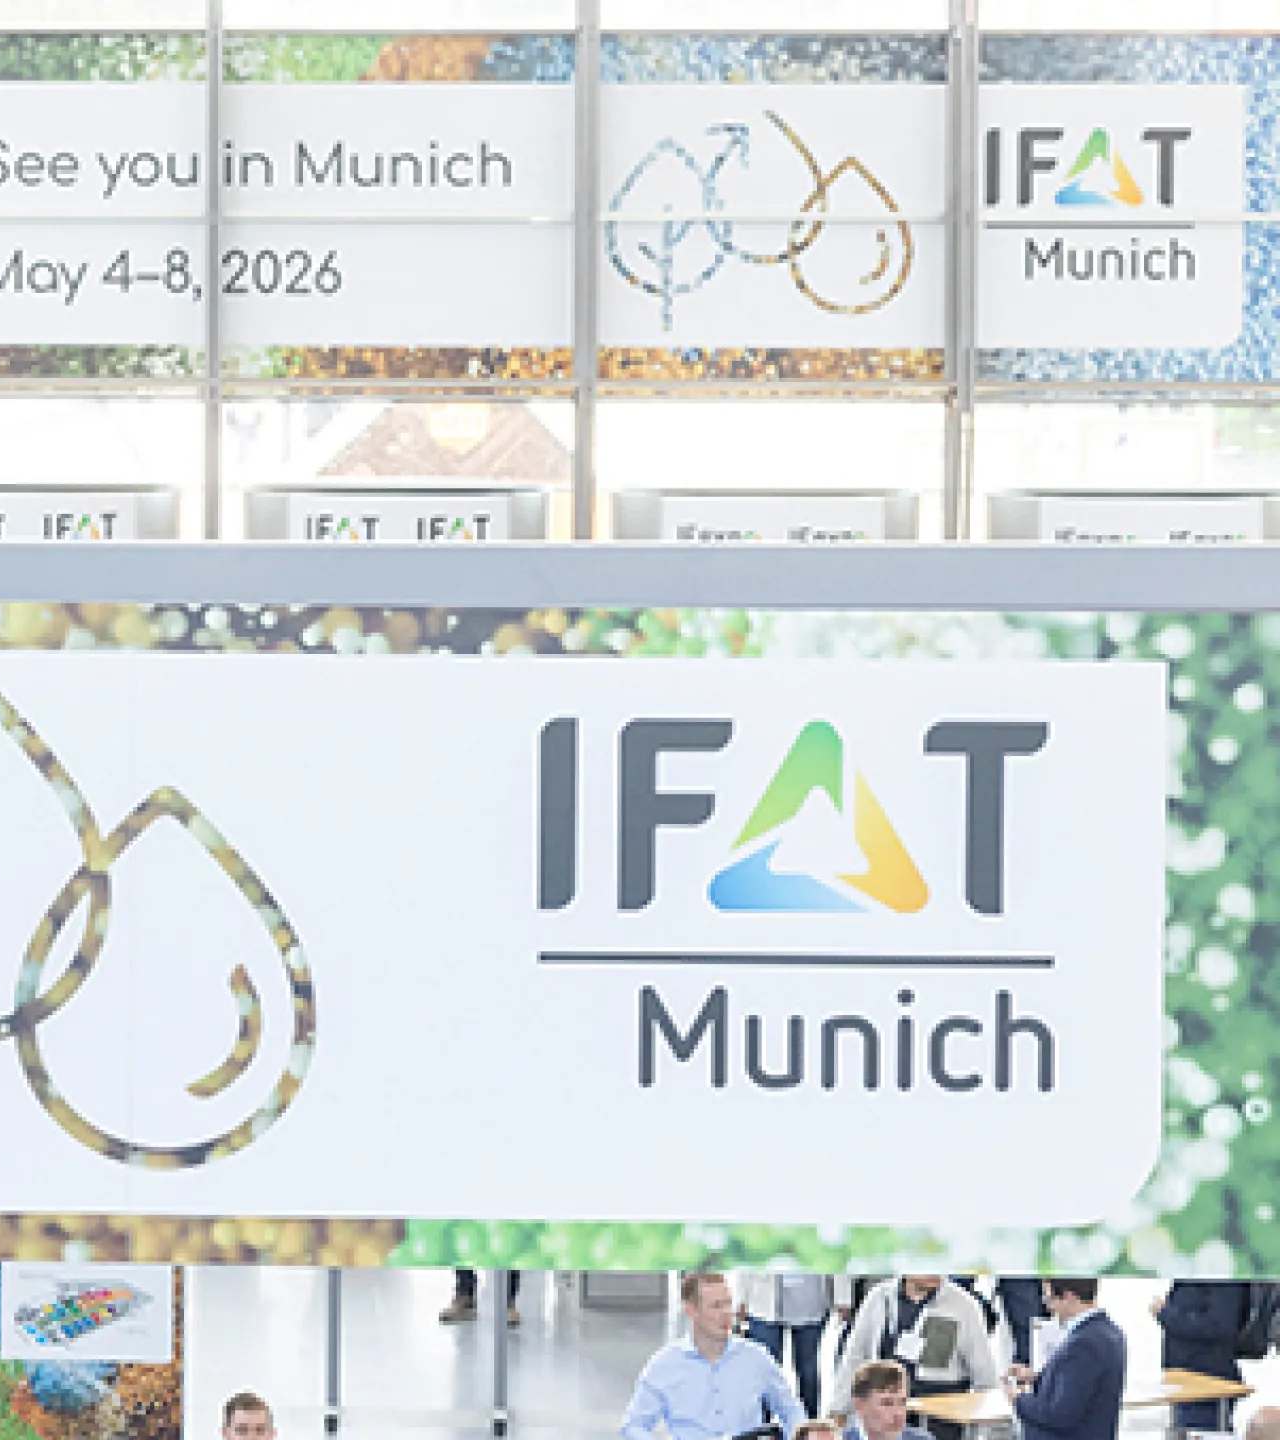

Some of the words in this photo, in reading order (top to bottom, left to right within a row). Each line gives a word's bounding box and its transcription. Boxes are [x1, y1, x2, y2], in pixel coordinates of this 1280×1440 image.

[98, 153, 198, 198] you
[223, 140, 272, 186] in
[296, 141, 511, 187] Munich
[985, 128, 1191, 207] IFAT
[221, 249, 342, 295] 2026
[1025, 238, 1195, 280] Munich
[537, 717, 1048, 915] IFAT
[639, 986, 1054, 1092] Munich
